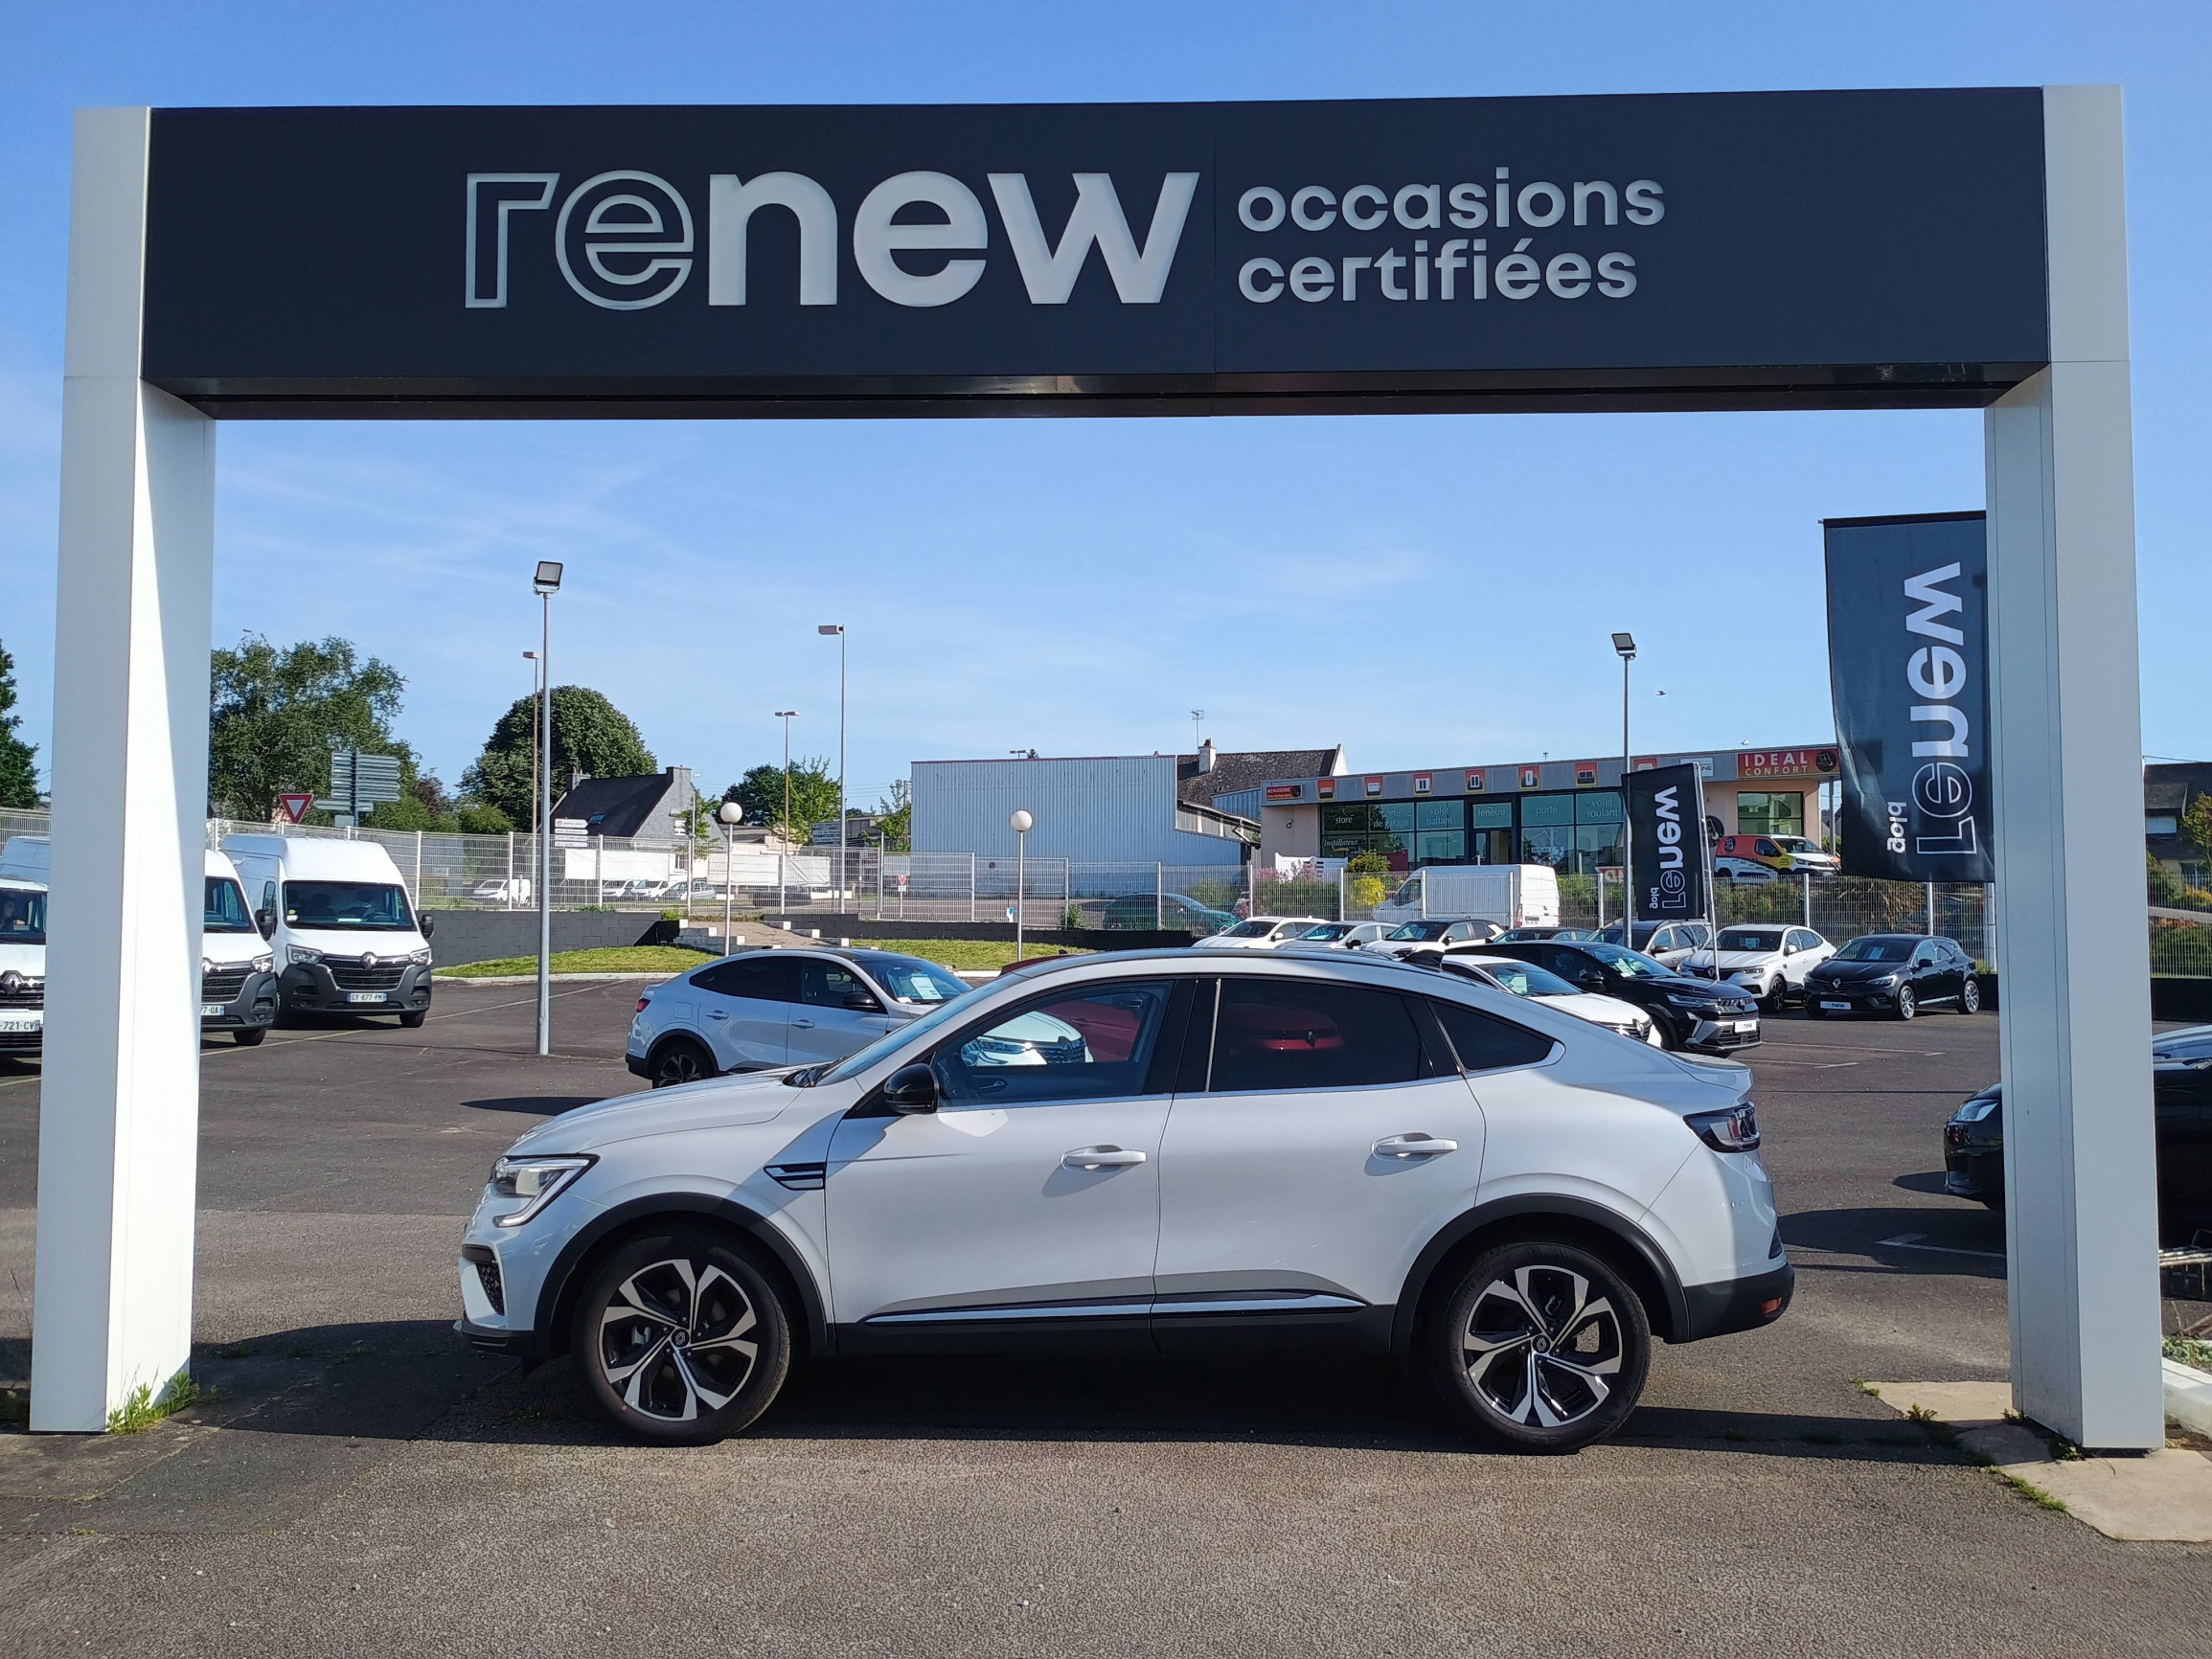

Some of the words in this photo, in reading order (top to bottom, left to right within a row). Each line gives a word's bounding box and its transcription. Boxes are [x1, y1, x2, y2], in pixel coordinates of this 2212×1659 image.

[1237, 166, 1666, 233] occasions
[465, 169, 1200, 310] renew
[1237, 237, 1638, 304] certifiées
[1745, 751, 1809, 767] IDEAL
[1745, 765, 1809, 777] CONFORT
[1591, 797, 1613, 807] volet
[1429, 806, 1449, 815] volet
[1536, 806, 1558, 816] porte
[1586, 807, 1619, 818] roulant
[1334, 815, 1354, 825] store
[1373, 818, 1382, 828] de
[1384, 819, 1409, 830] garage
[1425, 815, 1453, 826] battant
